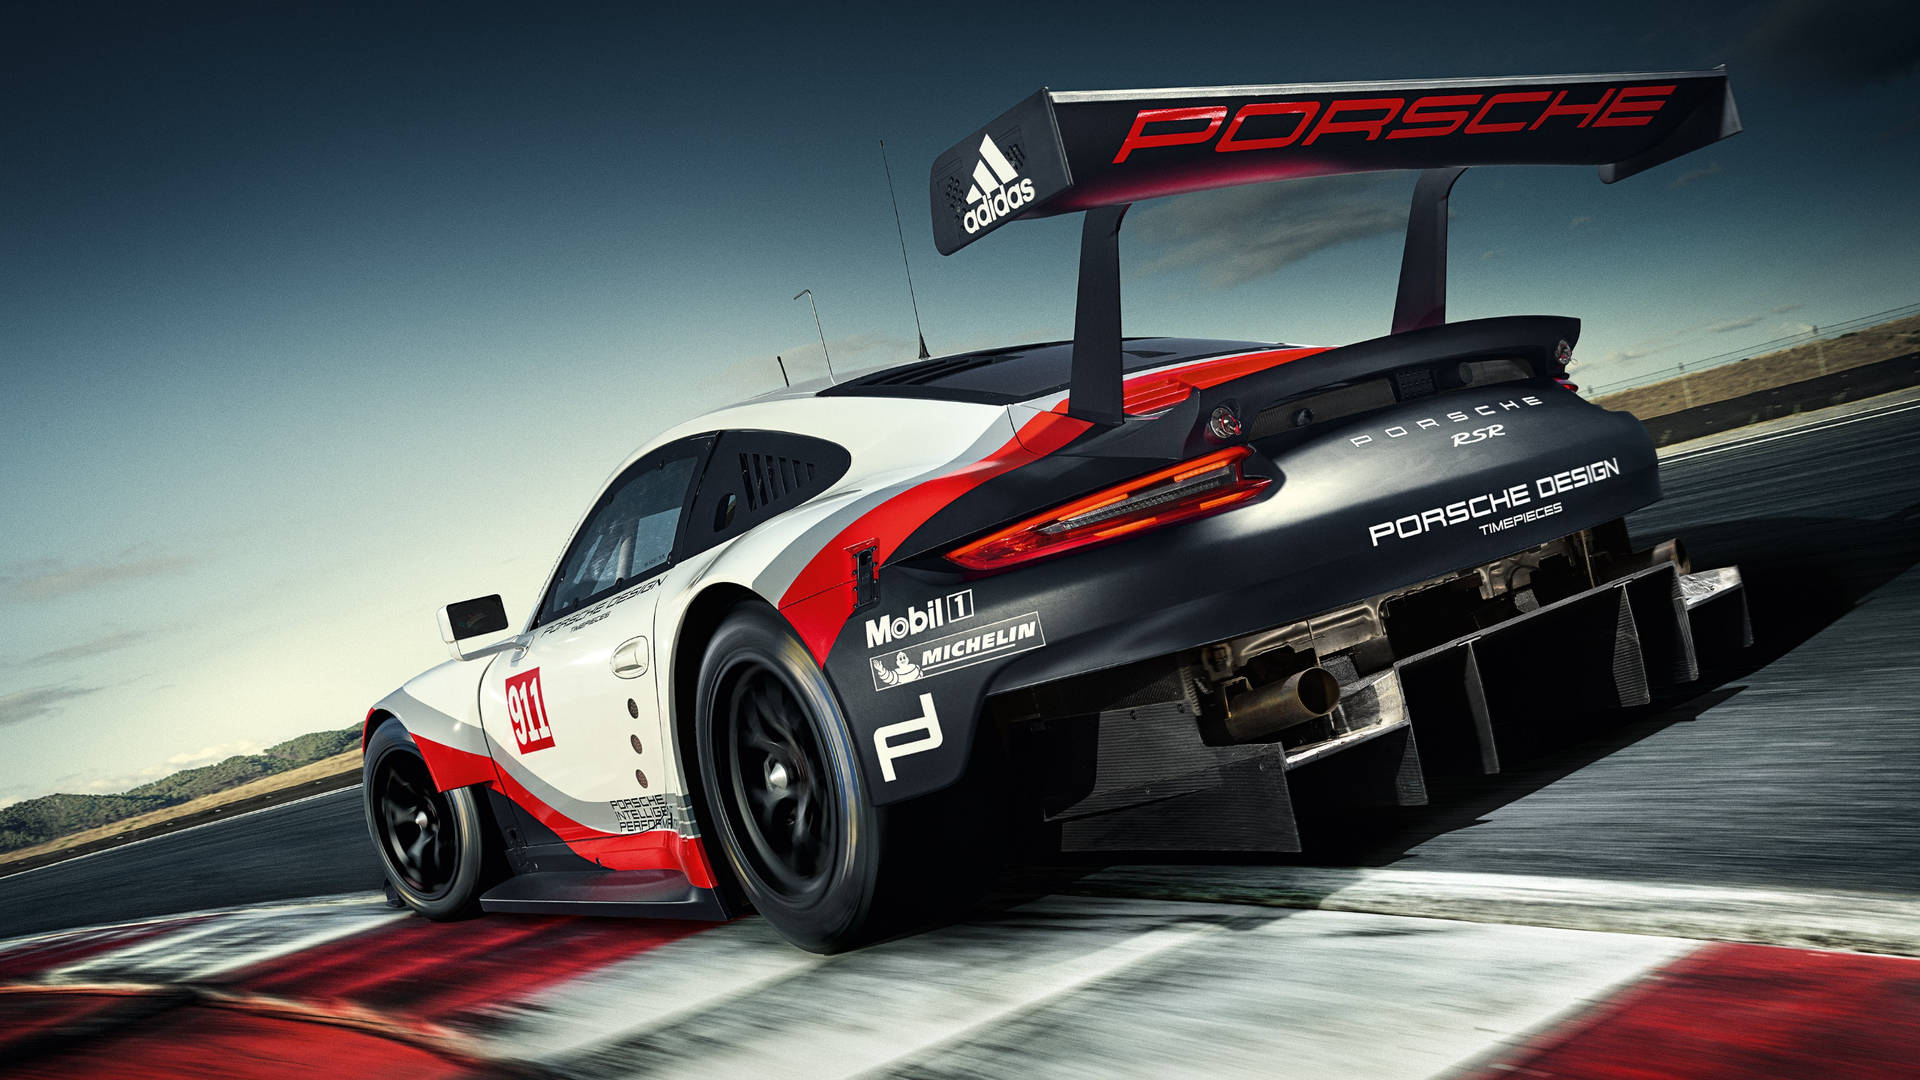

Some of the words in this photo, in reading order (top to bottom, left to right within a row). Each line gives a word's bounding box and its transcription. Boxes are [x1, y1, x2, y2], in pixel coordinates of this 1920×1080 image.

[1112, 85, 1677, 164] PORSCHE
[963, 177, 1036, 235] adidas
[1350, 395, 1543, 448] PORSCHE
[1450, 423, 1506, 448] RSR
[1367, 483, 1532, 548] PORSCHE
[1535, 457, 1621, 499] DESIGN
[1478, 501, 1564, 537] TIMEPIECES
[540, 601, 608, 638] PORSCHE
[606, 574, 669, 609] DESIGN
[865, 598, 944, 649] Mobil
[953, 594, 965, 618] 1
[921, 620, 1036, 666] MICHELIN
[508, 677, 552, 745] 911
[610, 794, 665, 809] PORSCHE
